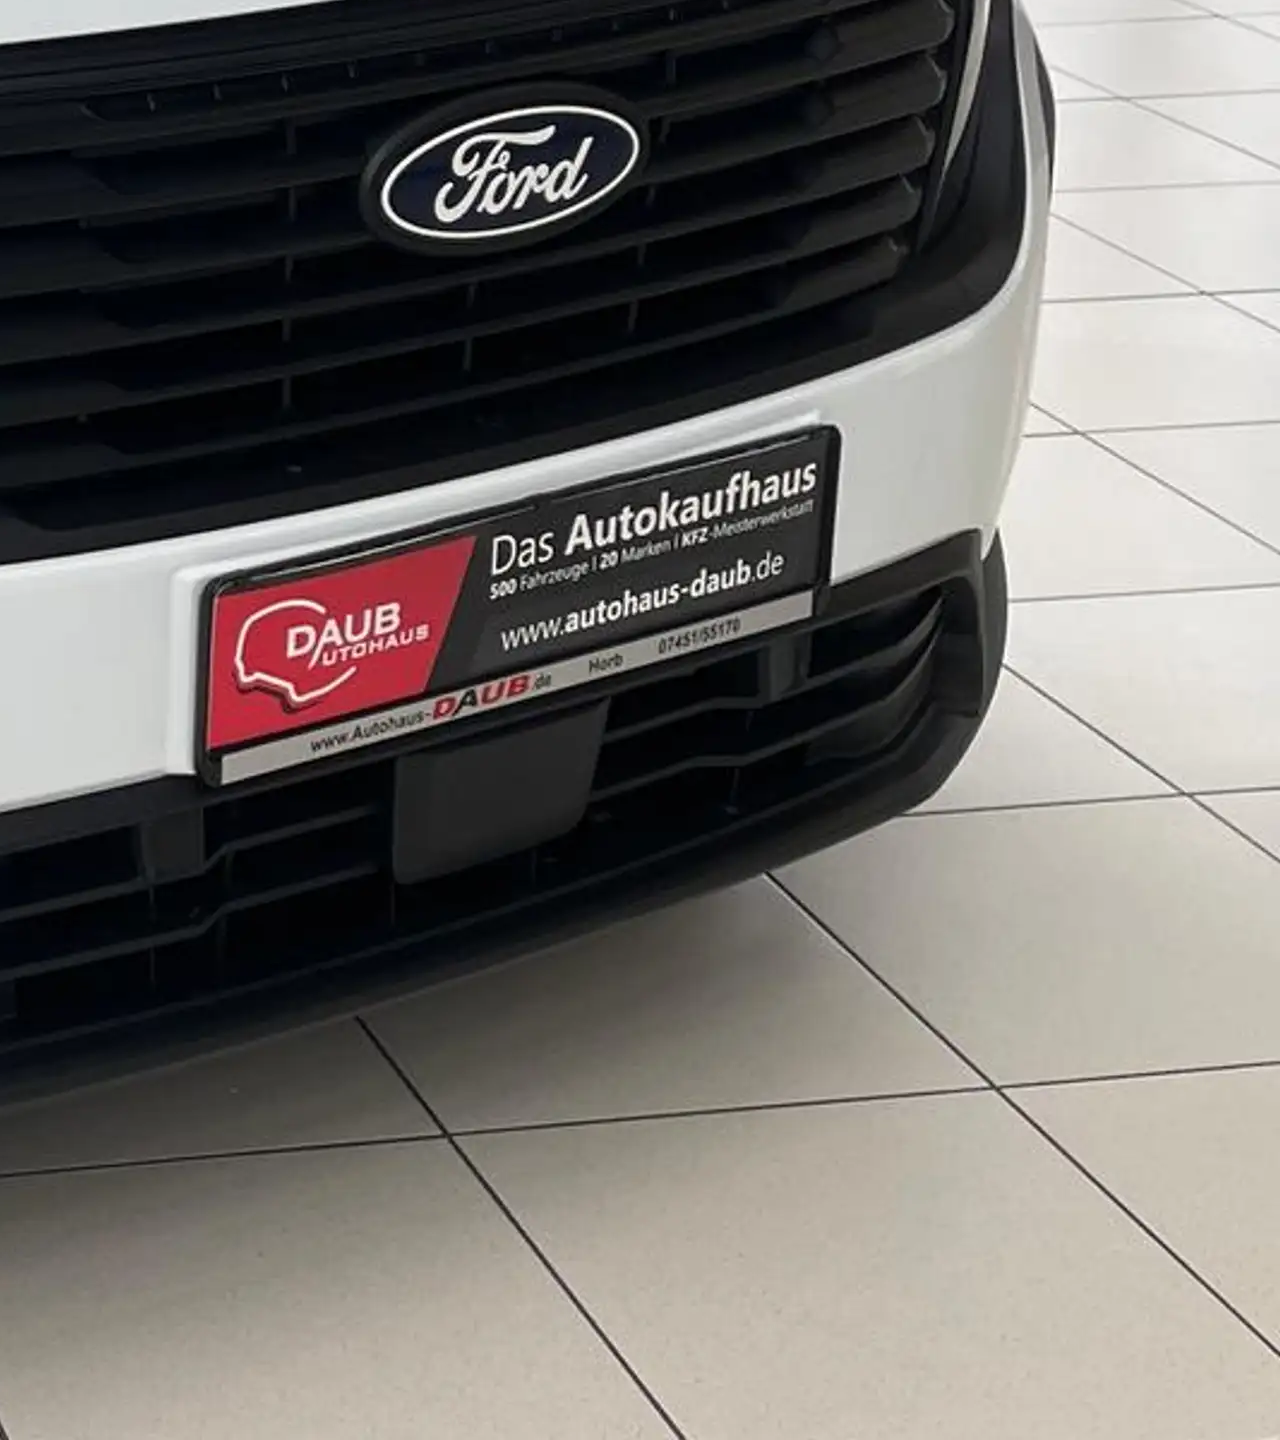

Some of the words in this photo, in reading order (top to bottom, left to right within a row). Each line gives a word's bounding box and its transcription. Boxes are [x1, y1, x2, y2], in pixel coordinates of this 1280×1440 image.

[433, 123, 595, 224] Ford
[490, 531, 556, 577] Das
[563, 462, 817, 557] Autokaufhaus
[488, 577, 518, 601] 500
[519, 560, 591, 592] Fahrzeuge
[598, 549, 620, 571] 20
[500, 549, 785, 652] www.autohaus-daub.de
[286, 601, 403, 671] DAUB
